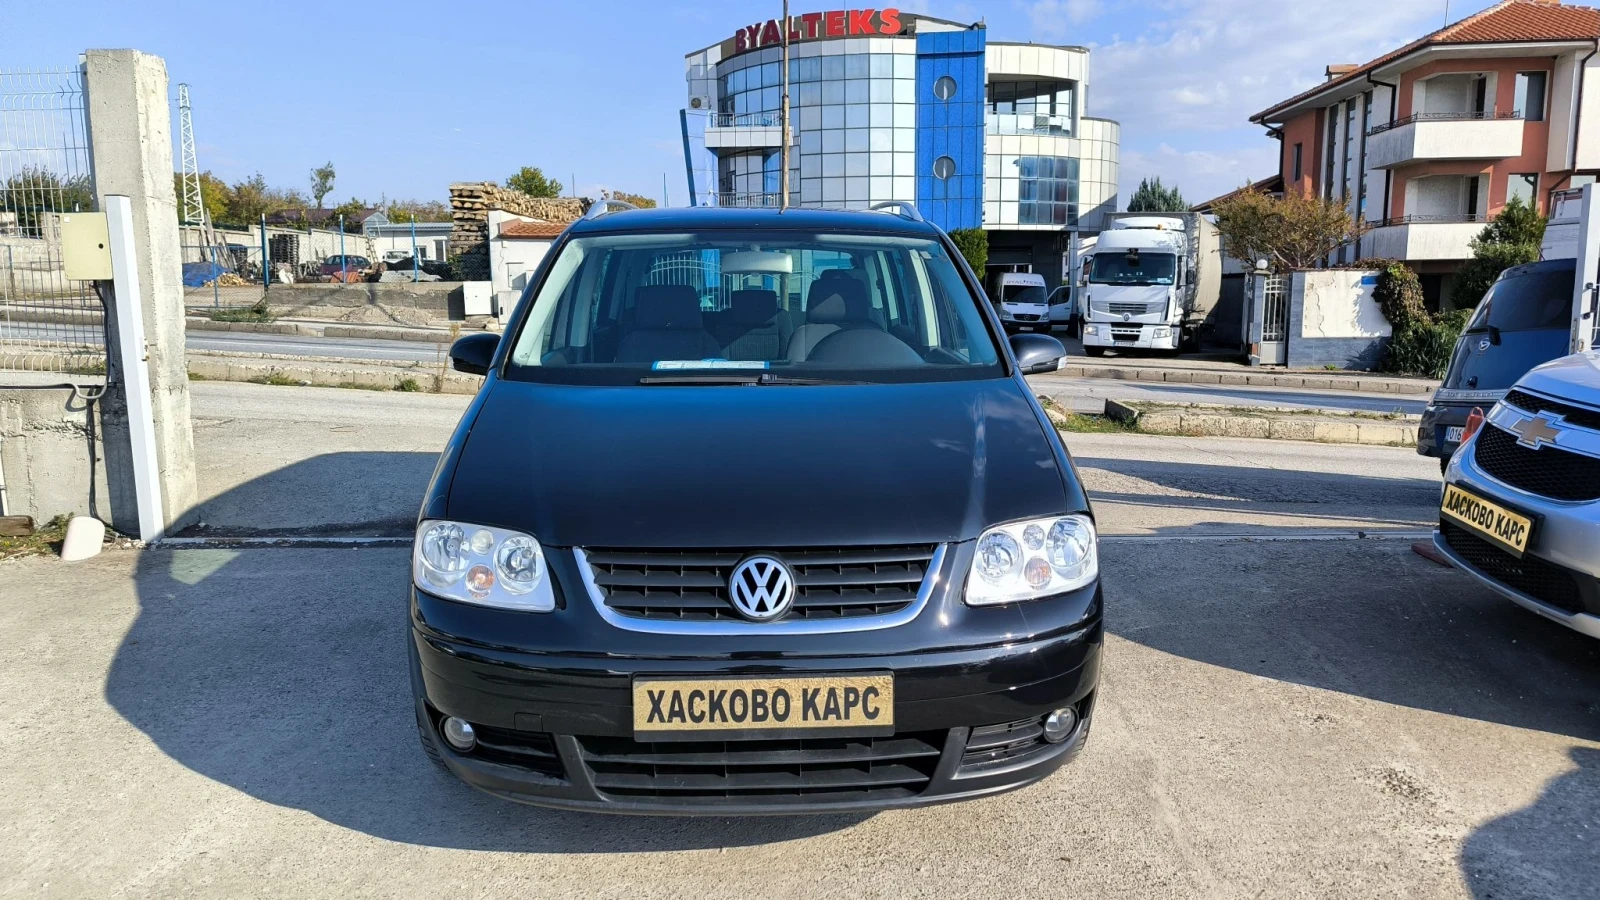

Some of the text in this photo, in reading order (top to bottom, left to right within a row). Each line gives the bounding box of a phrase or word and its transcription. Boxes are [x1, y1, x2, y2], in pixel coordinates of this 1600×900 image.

[735, 8, 902, 51] BYALTEKS
[1446, 489, 1525, 546] ХАСКОВО КАРС
[646, 686, 880, 723] ХАСКОВО КАРС
